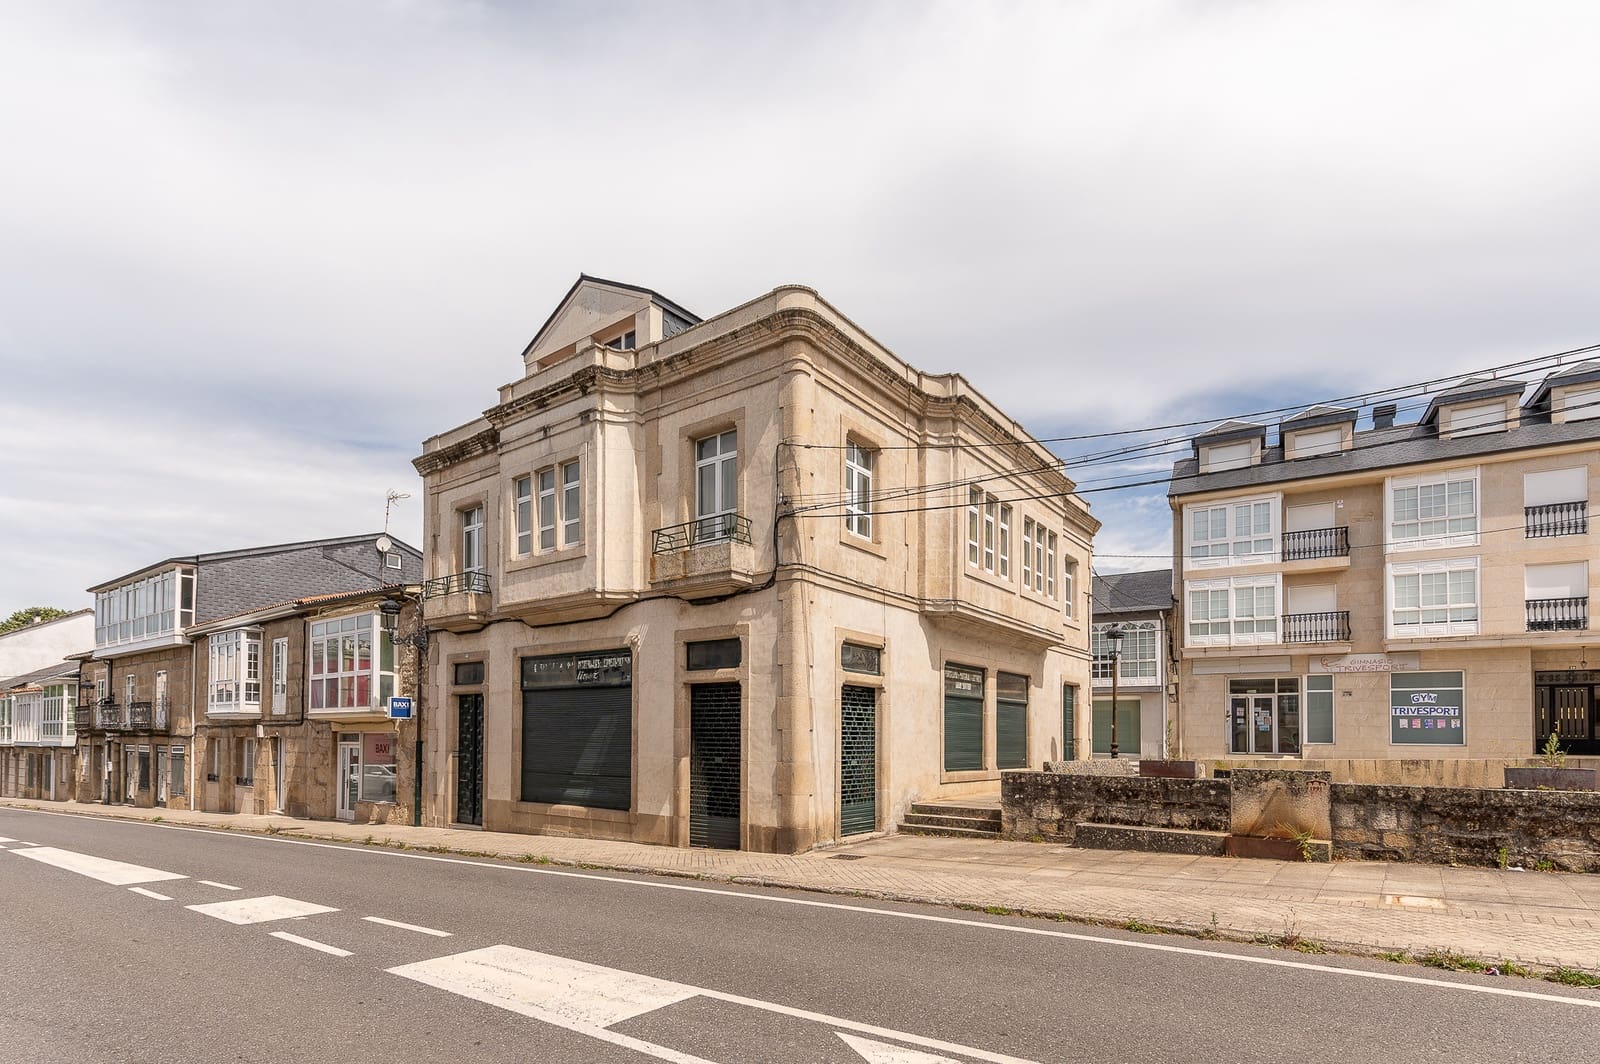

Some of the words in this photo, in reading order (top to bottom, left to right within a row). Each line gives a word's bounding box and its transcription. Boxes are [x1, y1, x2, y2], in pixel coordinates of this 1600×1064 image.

[1336, 663, 1408, 672] TRIVESPORT
[1412, 694, 1437, 703] GYM
[1393, 707, 1458, 715] TRIVESPORT
[375, 744, 389, 753] BAXI
